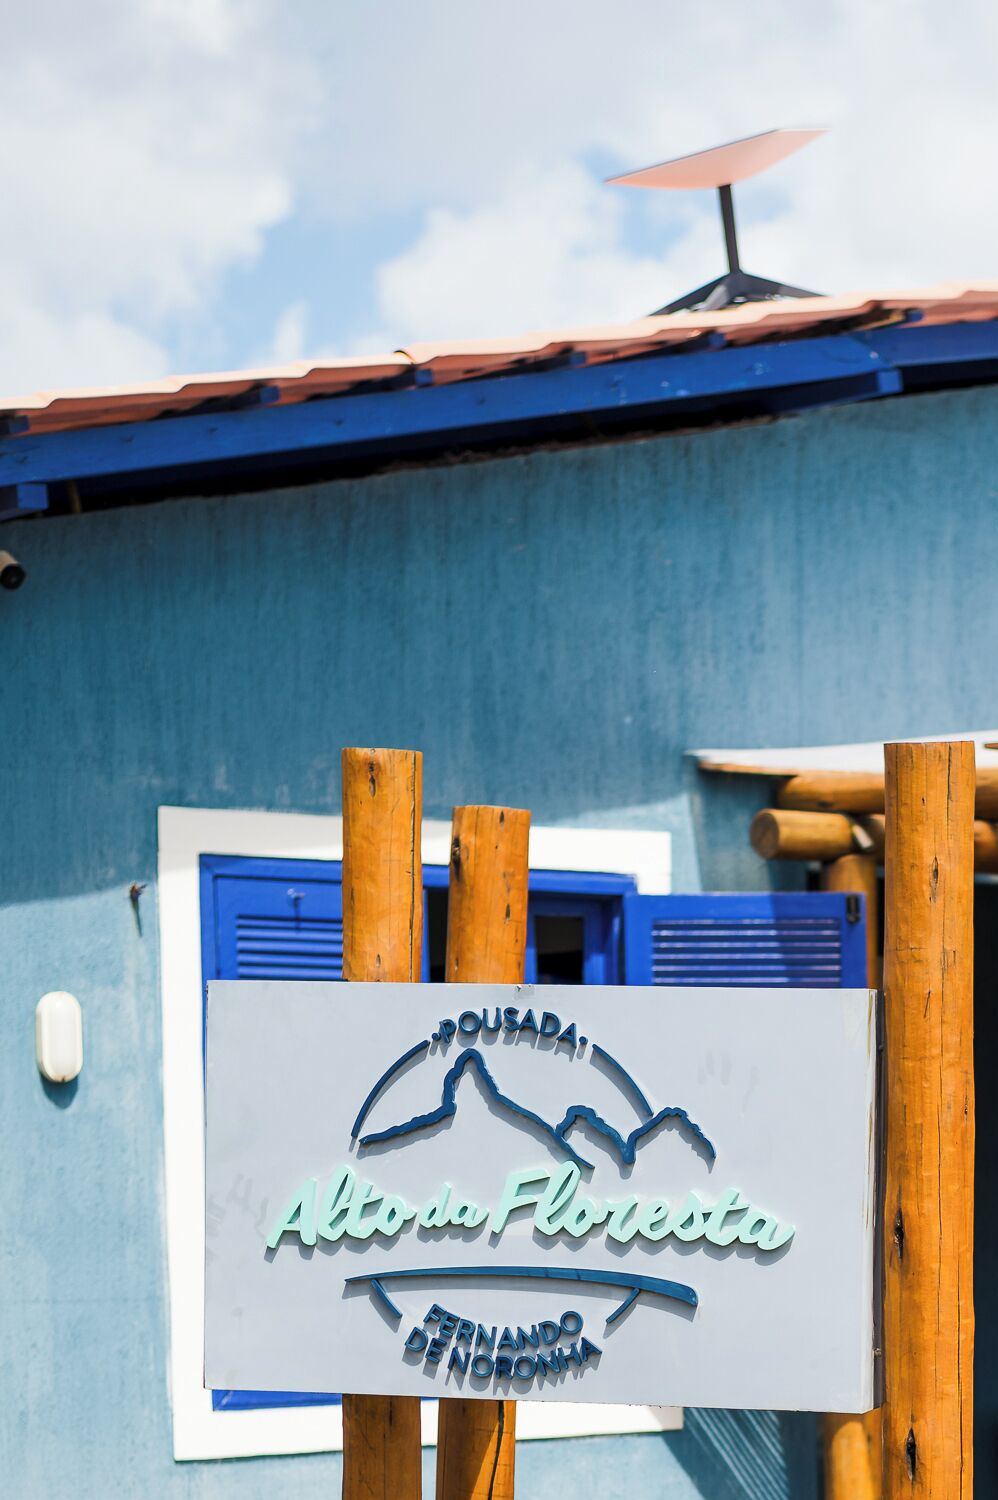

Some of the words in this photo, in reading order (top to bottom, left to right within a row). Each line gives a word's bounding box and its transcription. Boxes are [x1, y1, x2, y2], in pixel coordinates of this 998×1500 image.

[438, 1006, 577, 1048] POUSADA
[266, 1164, 417, 1249] Alto
[419, 1181, 490, 1228] da
[491, 1160, 796, 1250] Floresta
[423, 1303, 584, 1350] FERNANDO
[404, 1326, 447, 1364] DE
[447, 1336, 603, 1380] NORONHA
